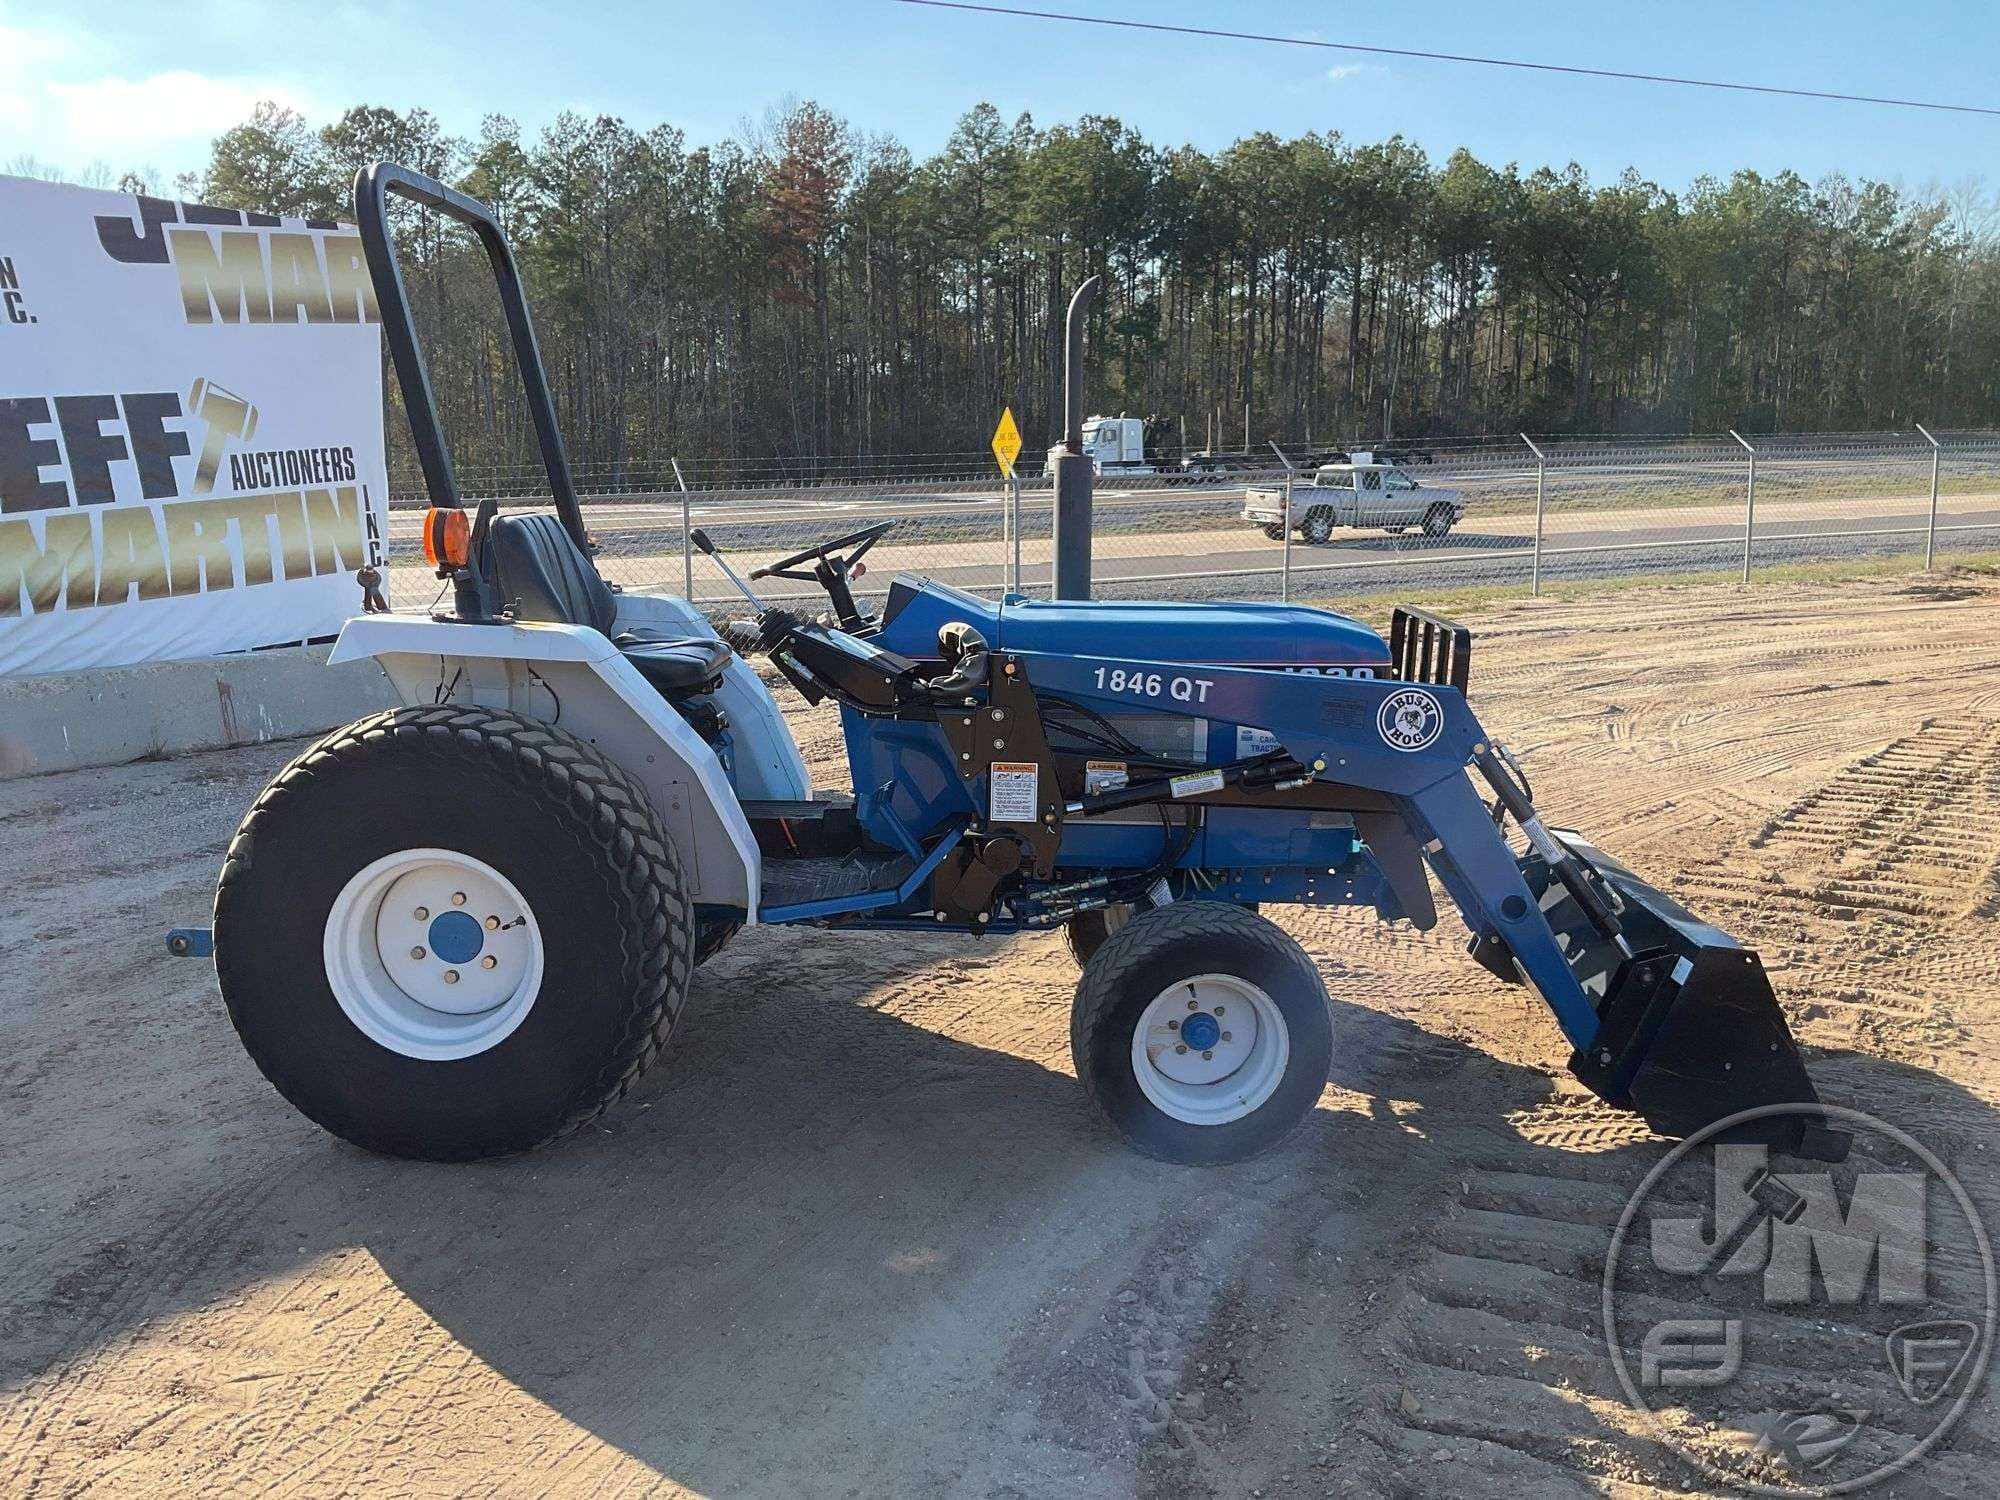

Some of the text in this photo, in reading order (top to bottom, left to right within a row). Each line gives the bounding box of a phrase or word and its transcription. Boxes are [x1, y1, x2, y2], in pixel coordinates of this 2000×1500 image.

[0, 394, 190, 513] EFF
[230, 447, 356, 491] AUCTIONEERS
[0, 486, 363, 617] MARTIN
[1094, 667, 1214, 703] 1846 QT
[1391, 694, 1434, 714] BUSH
[1390, 729, 1423, 745] HOG
